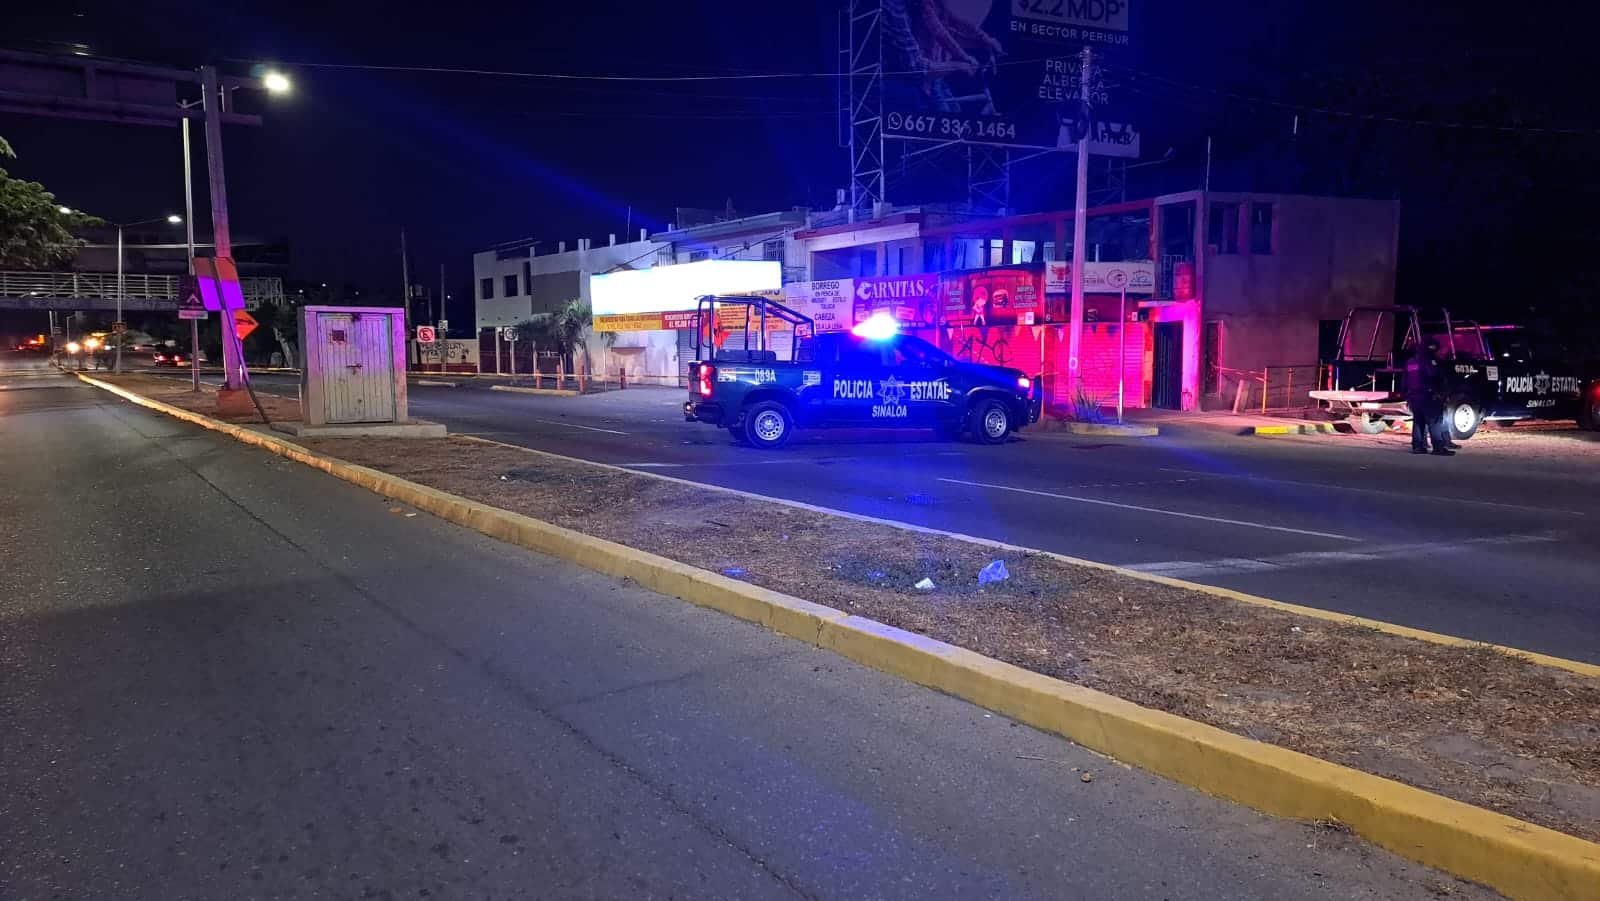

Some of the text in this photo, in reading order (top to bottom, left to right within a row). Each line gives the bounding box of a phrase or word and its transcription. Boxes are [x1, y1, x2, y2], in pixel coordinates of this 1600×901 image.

[1010, 20, 1129, 45] EN SECTOR PERISUR
[1046, 59, 1103, 77] PRIVA
[1043, 74, 1105, 90] ALBEA
[1039, 86, 1109, 104] ELEVAOR
[904, 114, 936, 132] 667
[811, 281, 840, 290] BORREGO
[856, 280, 924, 300] CARNITAS
[754, 369, 777, 383] 089A
[1551, 376, 1580, 393] ESTATAL
[833, 378, 950, 400] POLICIA ESTATAL
[872, 405, 908, 418] SINALOA
